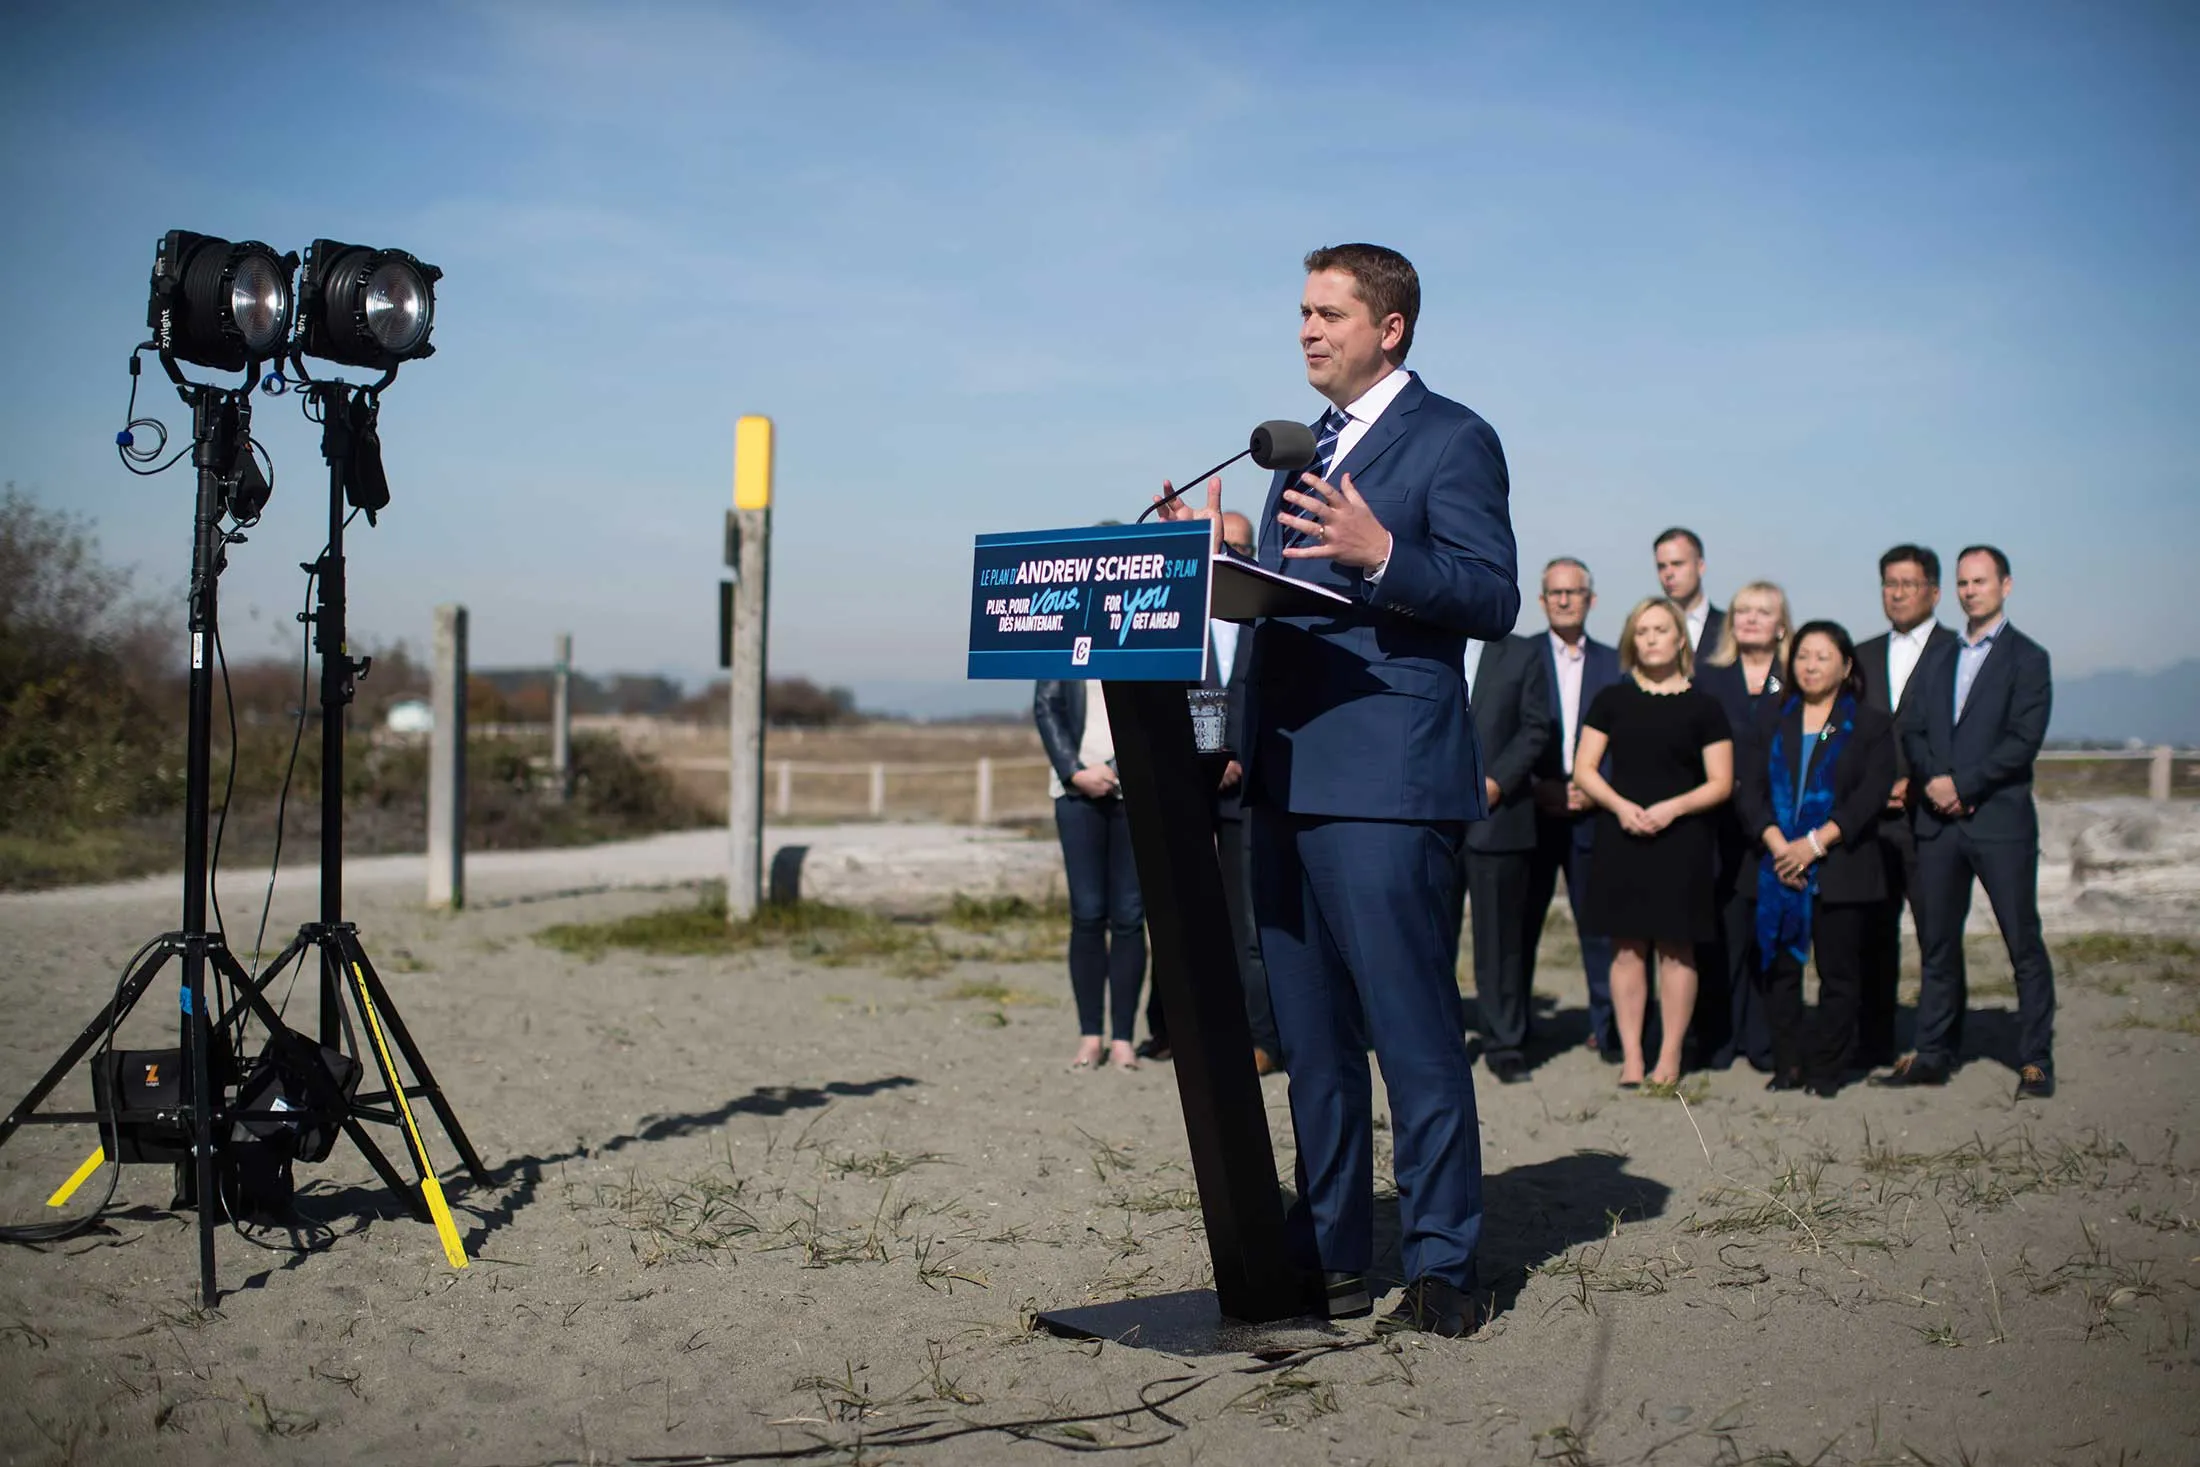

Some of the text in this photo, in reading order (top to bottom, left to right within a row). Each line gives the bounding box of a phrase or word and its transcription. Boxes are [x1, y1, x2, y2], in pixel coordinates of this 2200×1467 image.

[160, 309, 171, 349] zylight
[980, 569, 990, 586] LE
[989, 568, 1010, 586] PLAN
[1173, 559, 1198, 578] PLAN
[986, 599, 1007, 615] PLUS.
[1008, 598, 1030, 614] POUR
[1104, 595, 1121, 612] FOR
[998, 614, 1064, 632] DÈS MAINTENANT.
[1110, 612, 1180, 630] TO GET AHEAD
